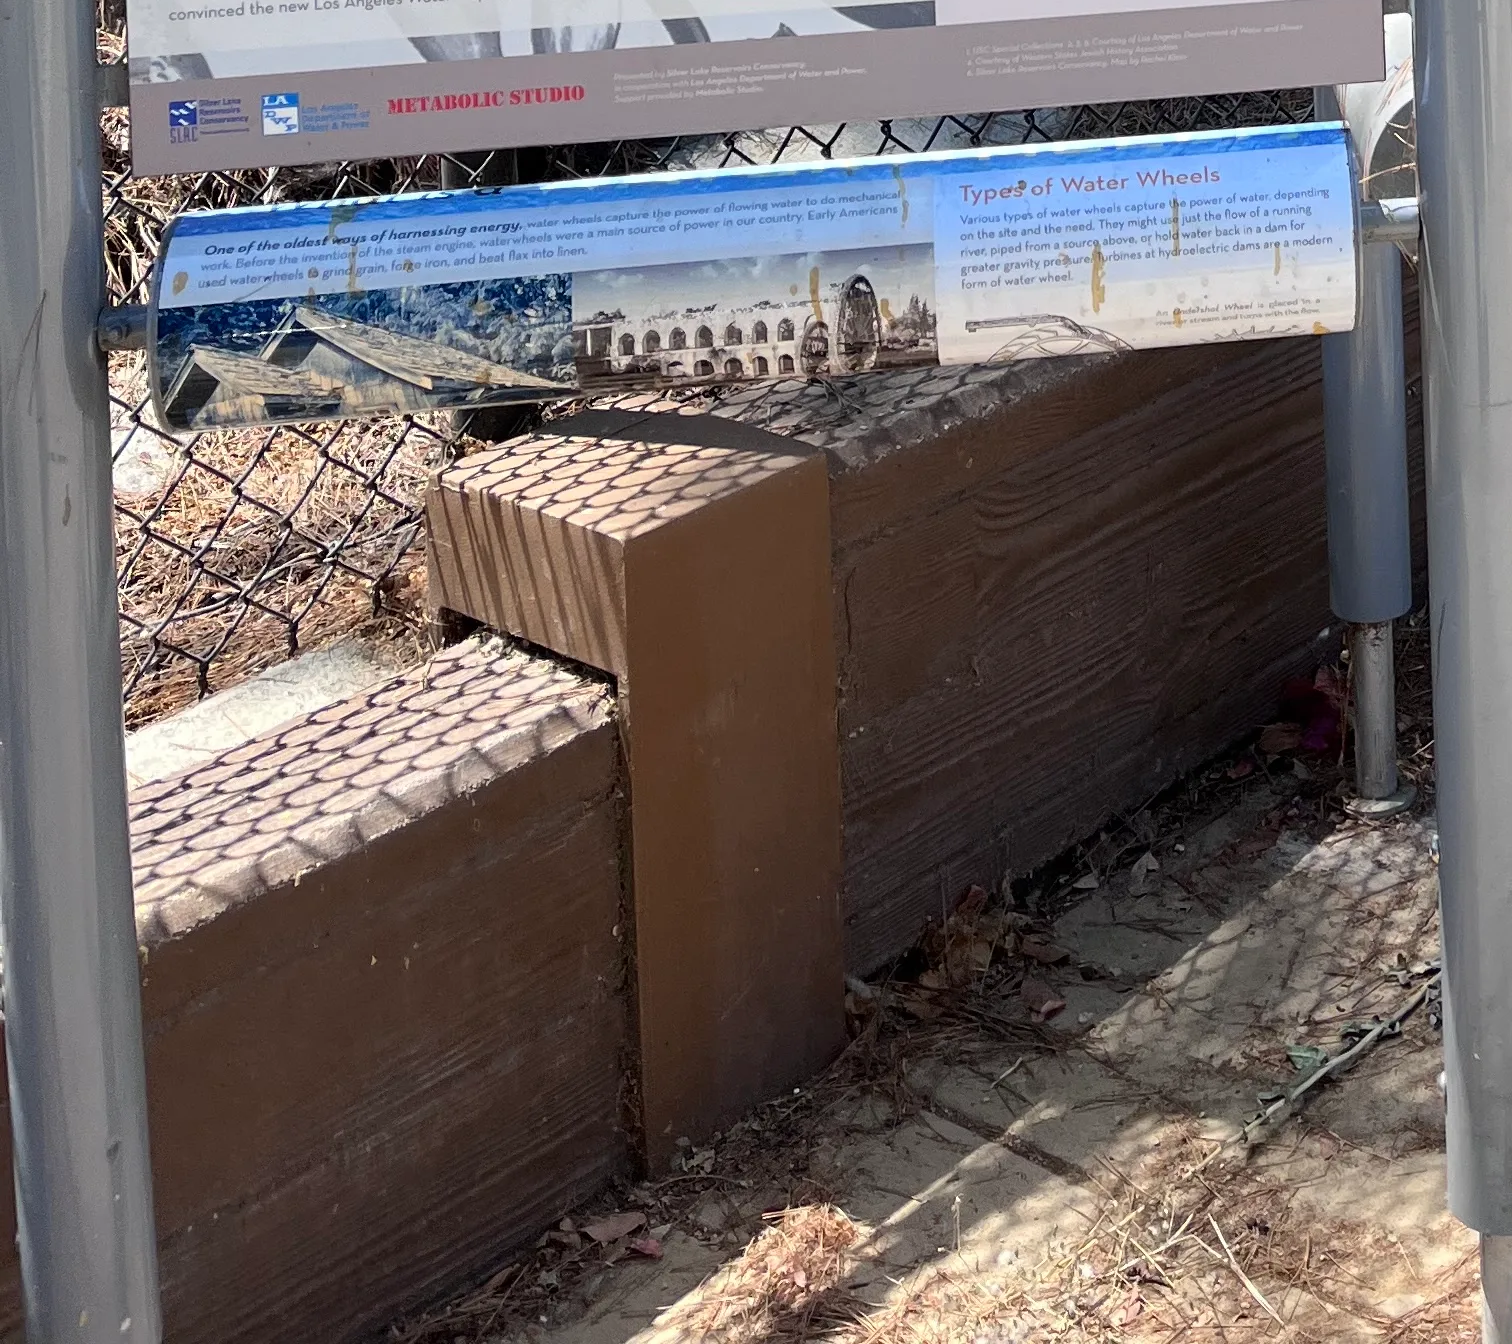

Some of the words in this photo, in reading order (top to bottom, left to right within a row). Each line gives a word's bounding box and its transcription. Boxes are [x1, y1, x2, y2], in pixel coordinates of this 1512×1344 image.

[388, 90, 503, 114] METABOLIC
[510, 84, 584, 104] STUDIO
[958, 179, 1027, 206] Types
[1031, 177, 1052, 195] of
[1061, 175, 1129, 192] Water
[1136, 165, 1219, 186] Wheels
[205, 245, 234, 256] One
[238, 242, 256, 259] of
[258, 241, 280, 252] the
[284, 235, 329, 250] oldest
[332, 235, 367, 250] ways
[371, 230, 388, 246] of
[389, 224, 466, 242] harnessing
[470, 221, 523, 236] energy,
